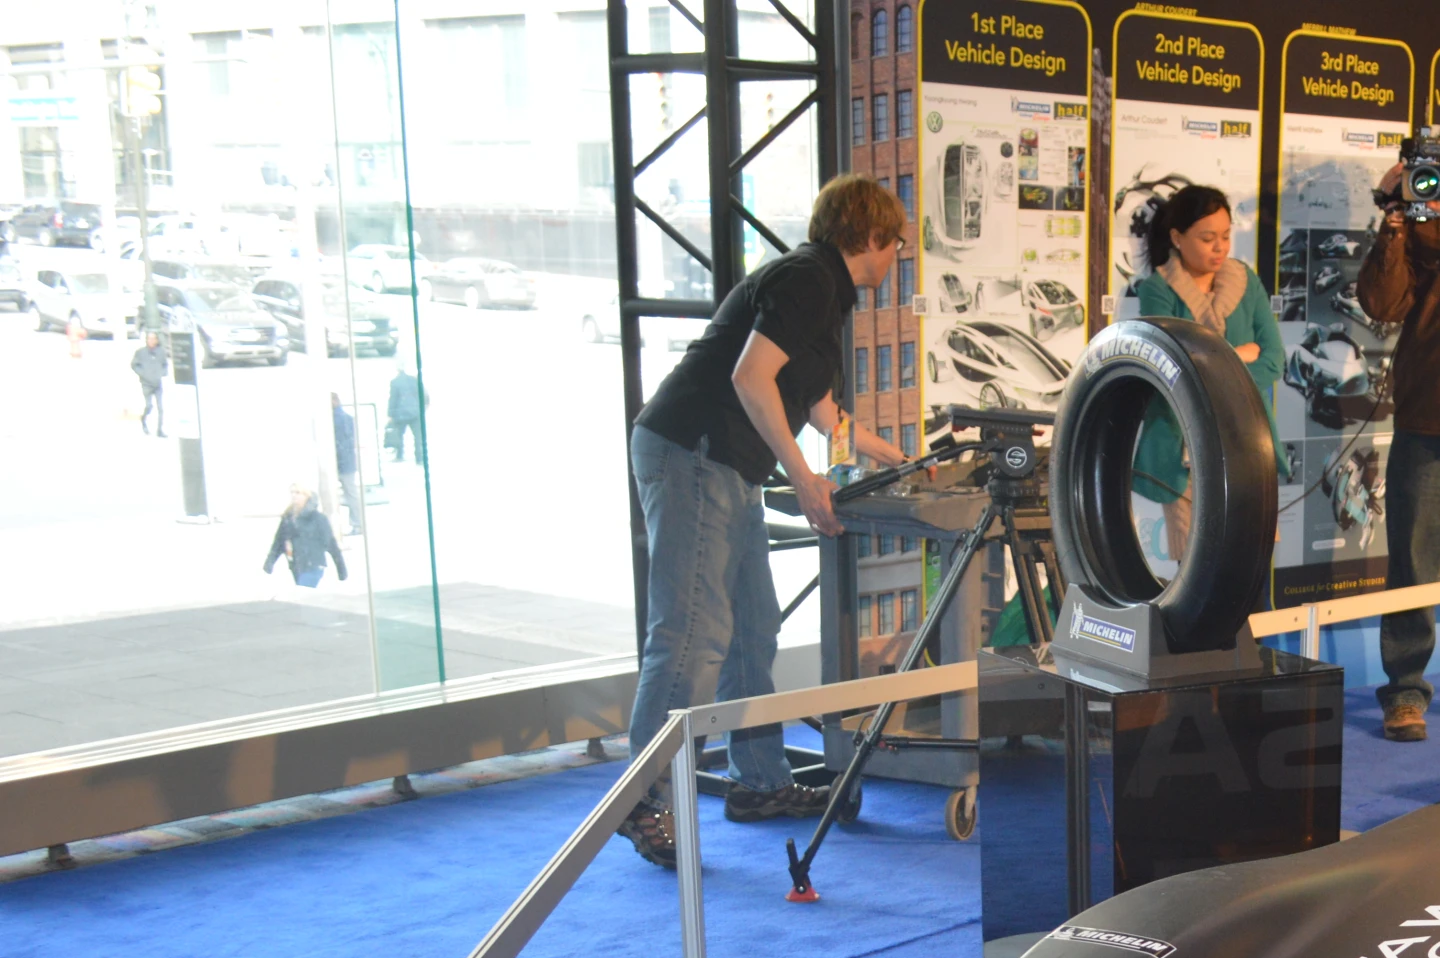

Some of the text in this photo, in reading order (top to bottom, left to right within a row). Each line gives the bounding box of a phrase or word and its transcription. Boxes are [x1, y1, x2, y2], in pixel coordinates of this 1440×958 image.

[970, 12, 1044, 40] 1st Place
[945, 39, 1066, 76] Vehicle Design
[1155, 33, 1225, 59] 2nd Place
[1136, 60, 1241, 93] Vehicle Design
[1320, 52, 1379, 76] 3rd Place
[1302, 77, 1395, 107] Vehicle Design
[1101, 339, 1178, 380] MICHELIN
[1083, 620, 1134, 646] MICHELIN
[1076, 930, 1169, 951] MICHELIN
